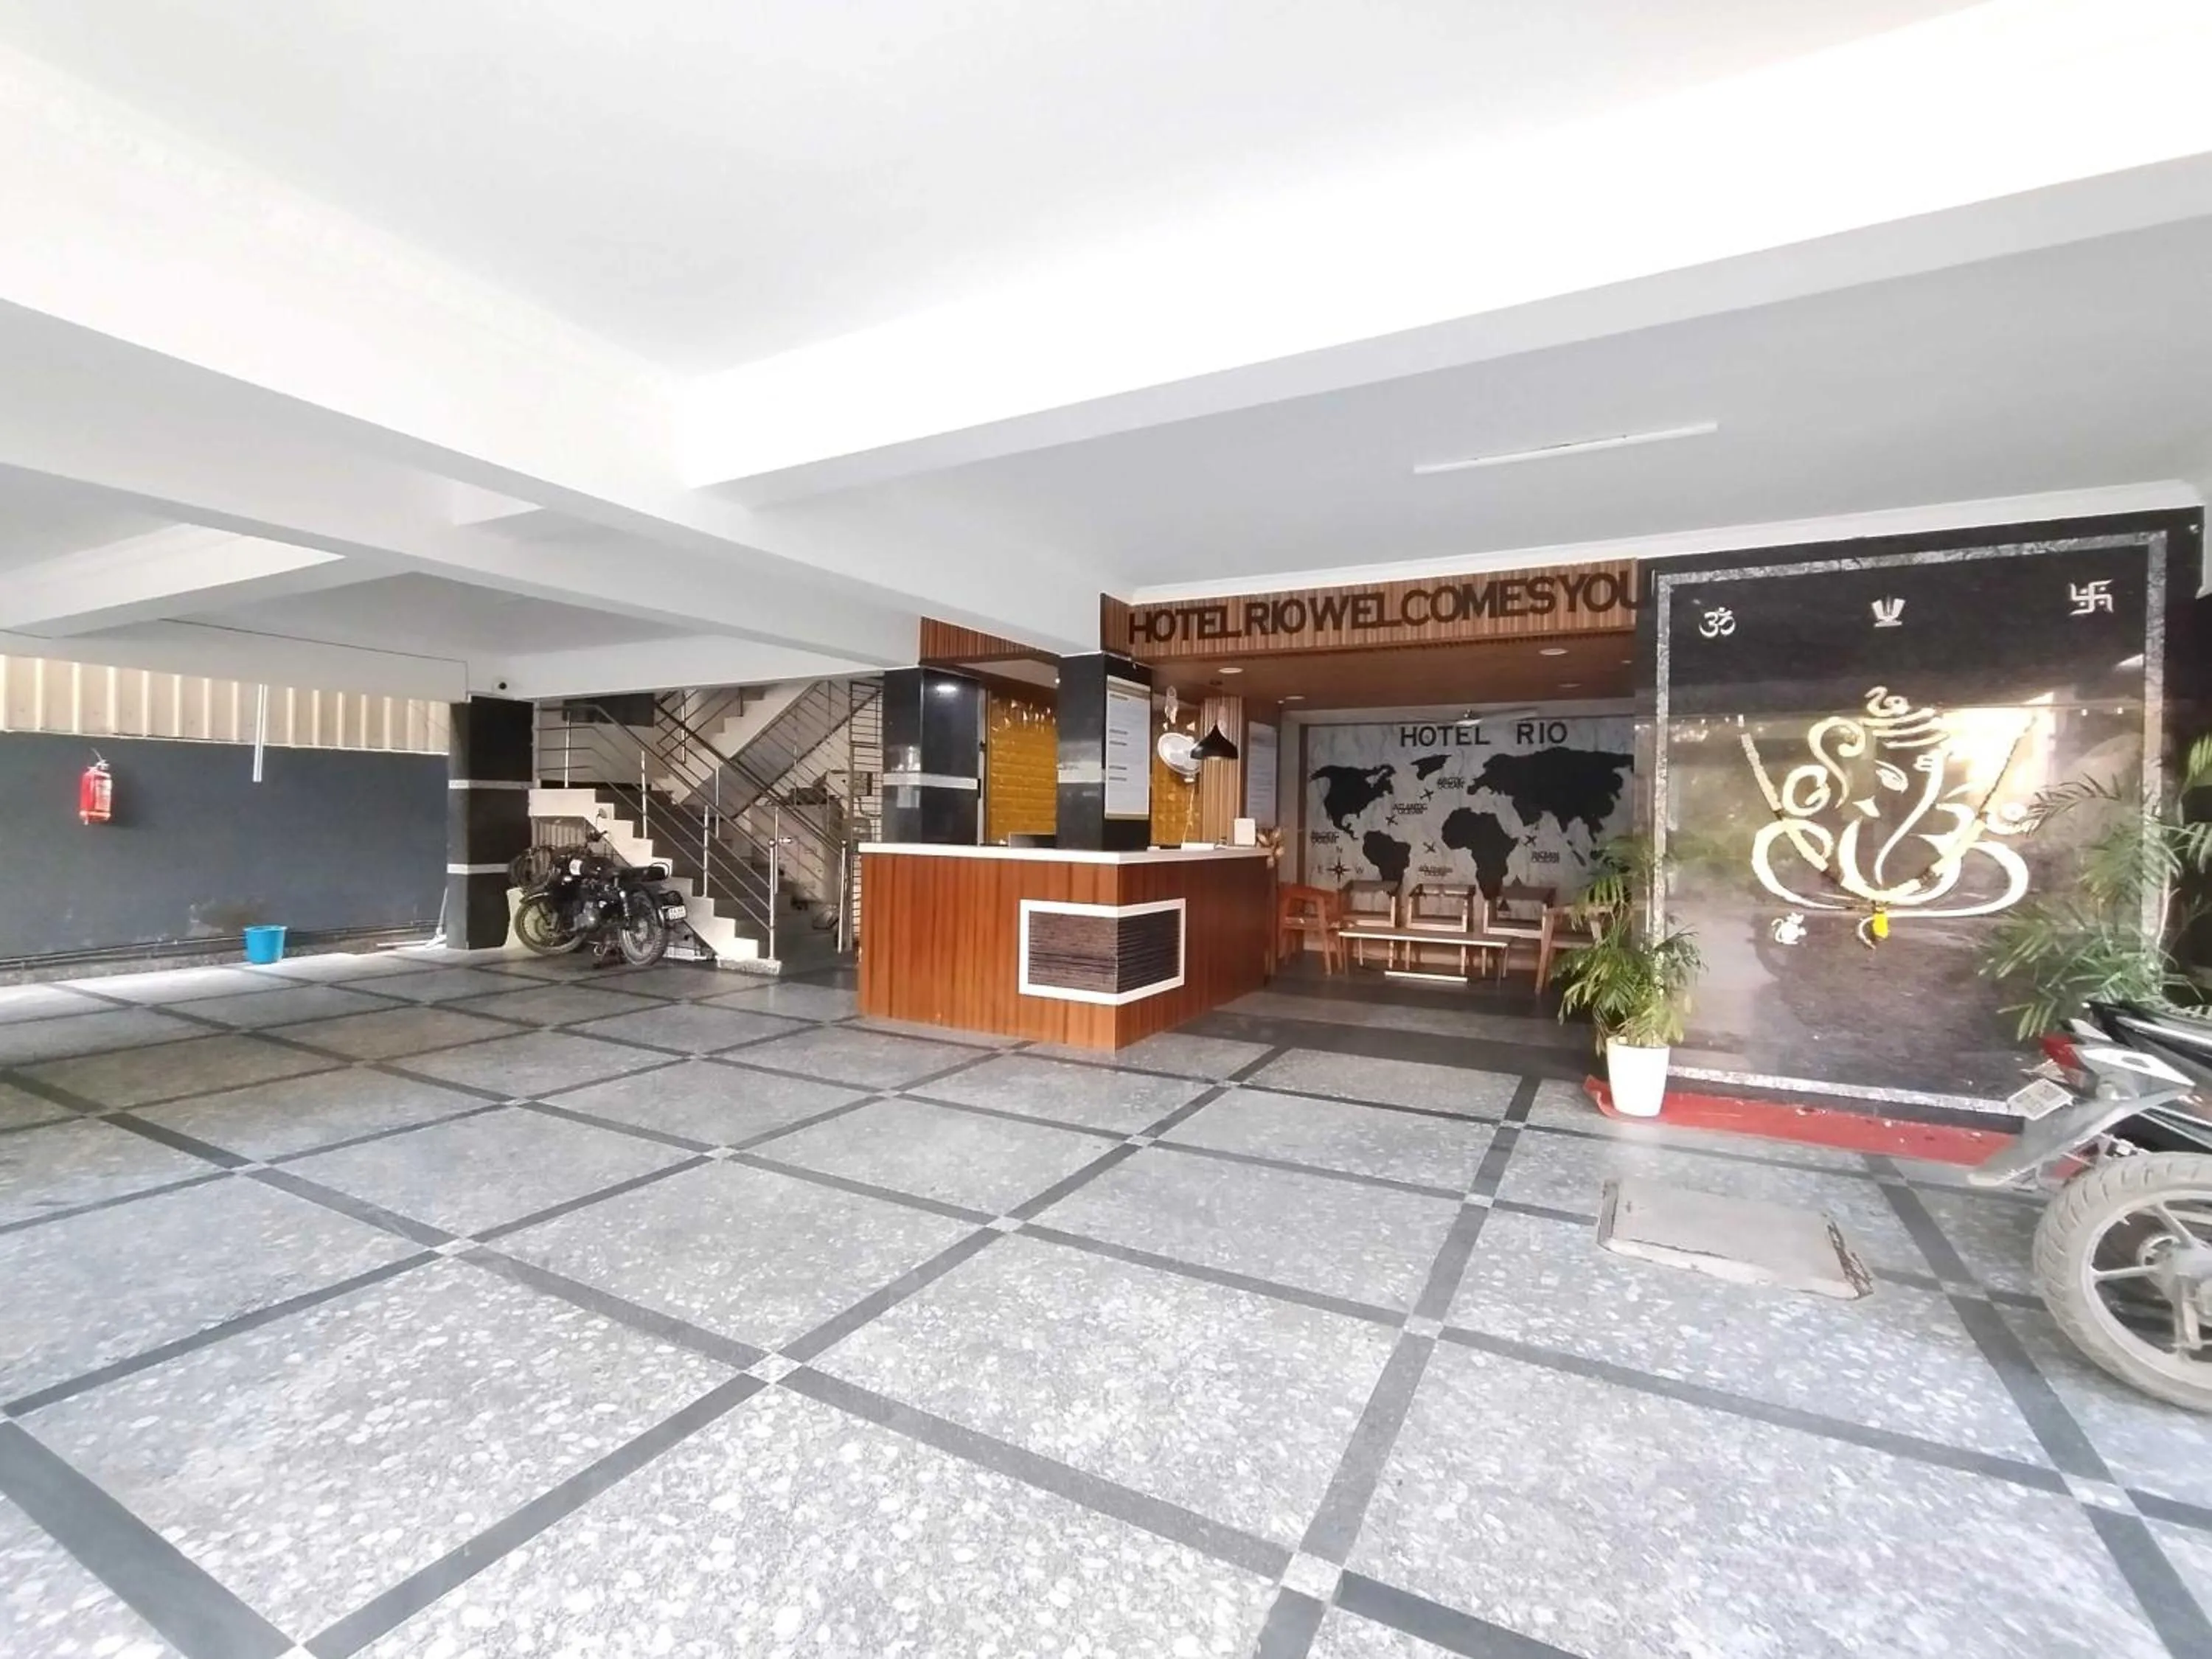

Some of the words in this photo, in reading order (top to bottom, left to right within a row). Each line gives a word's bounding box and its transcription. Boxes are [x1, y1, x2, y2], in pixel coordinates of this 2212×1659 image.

[1129, 605, 1242, 644] HOTEL
[1244, 598, 1307, 636] RIO
[1308, 576, 1556, 632] WELCOMES
[1400, 725, 1491, 747] HOTEL
[1516, 721, 1568, 745] RIO
